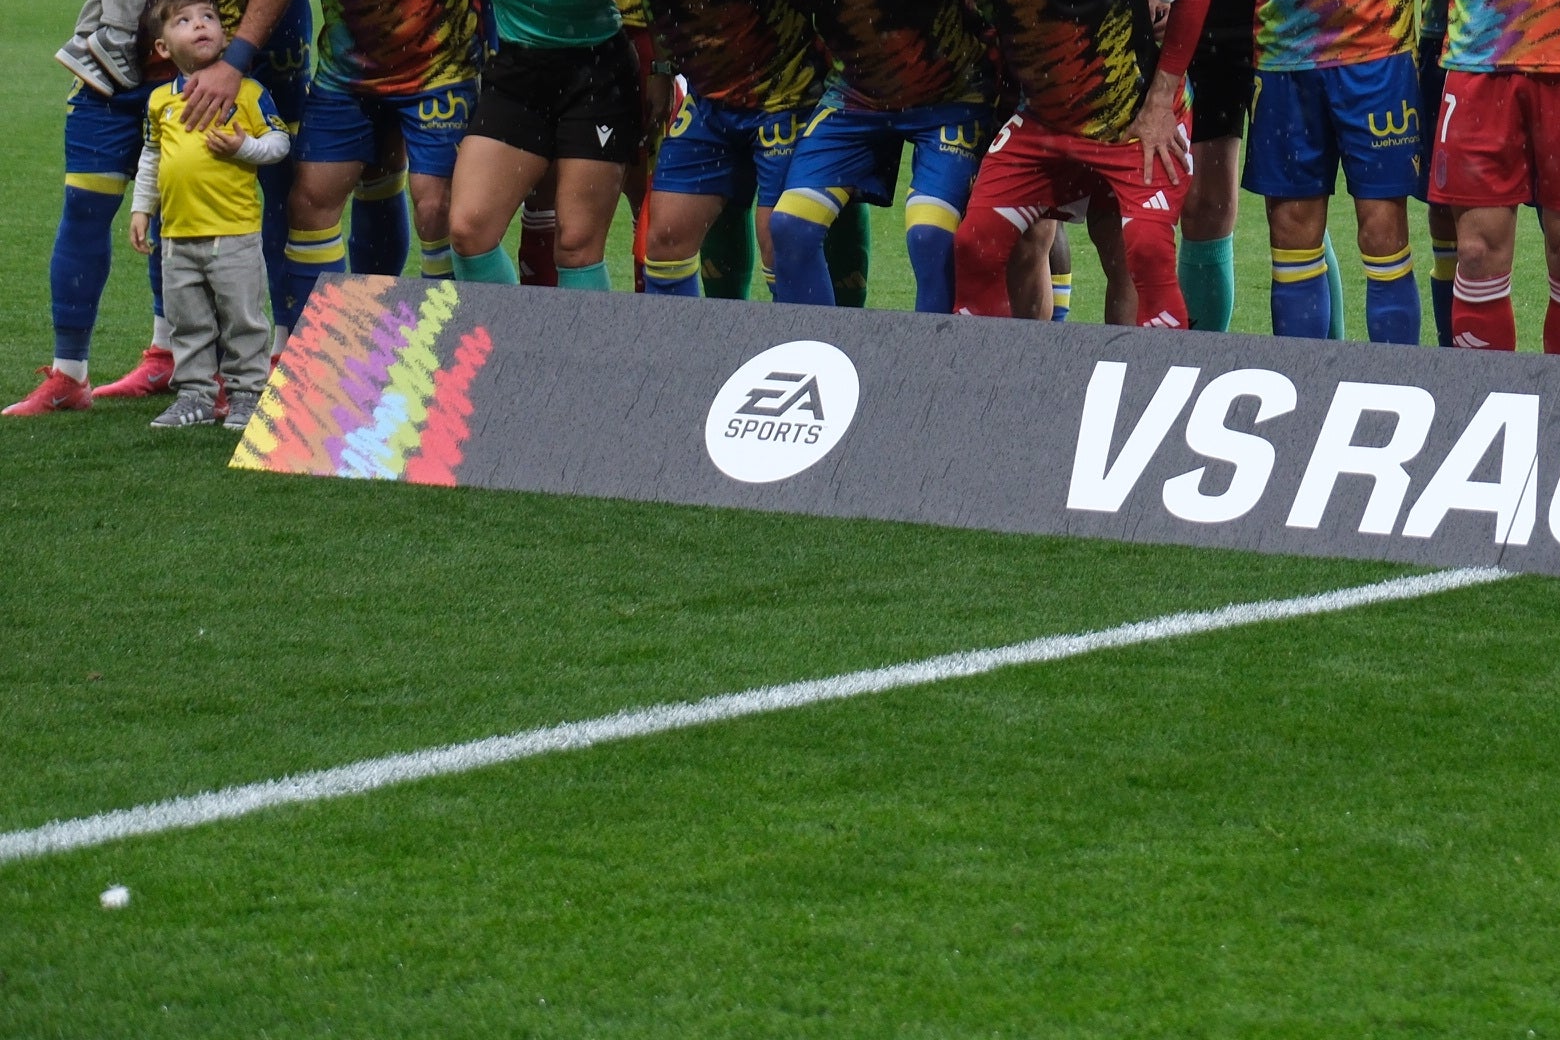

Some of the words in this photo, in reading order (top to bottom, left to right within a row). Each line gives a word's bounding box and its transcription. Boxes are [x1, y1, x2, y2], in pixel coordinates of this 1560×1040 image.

[1368, 99, 1420, 137] wh
[1440, 93, 1457, 143] 7
[735, 372, 825, 421] EA
[724, 418, 823, 444] SPORTS
[1067, 361, 1298, 523] VS
